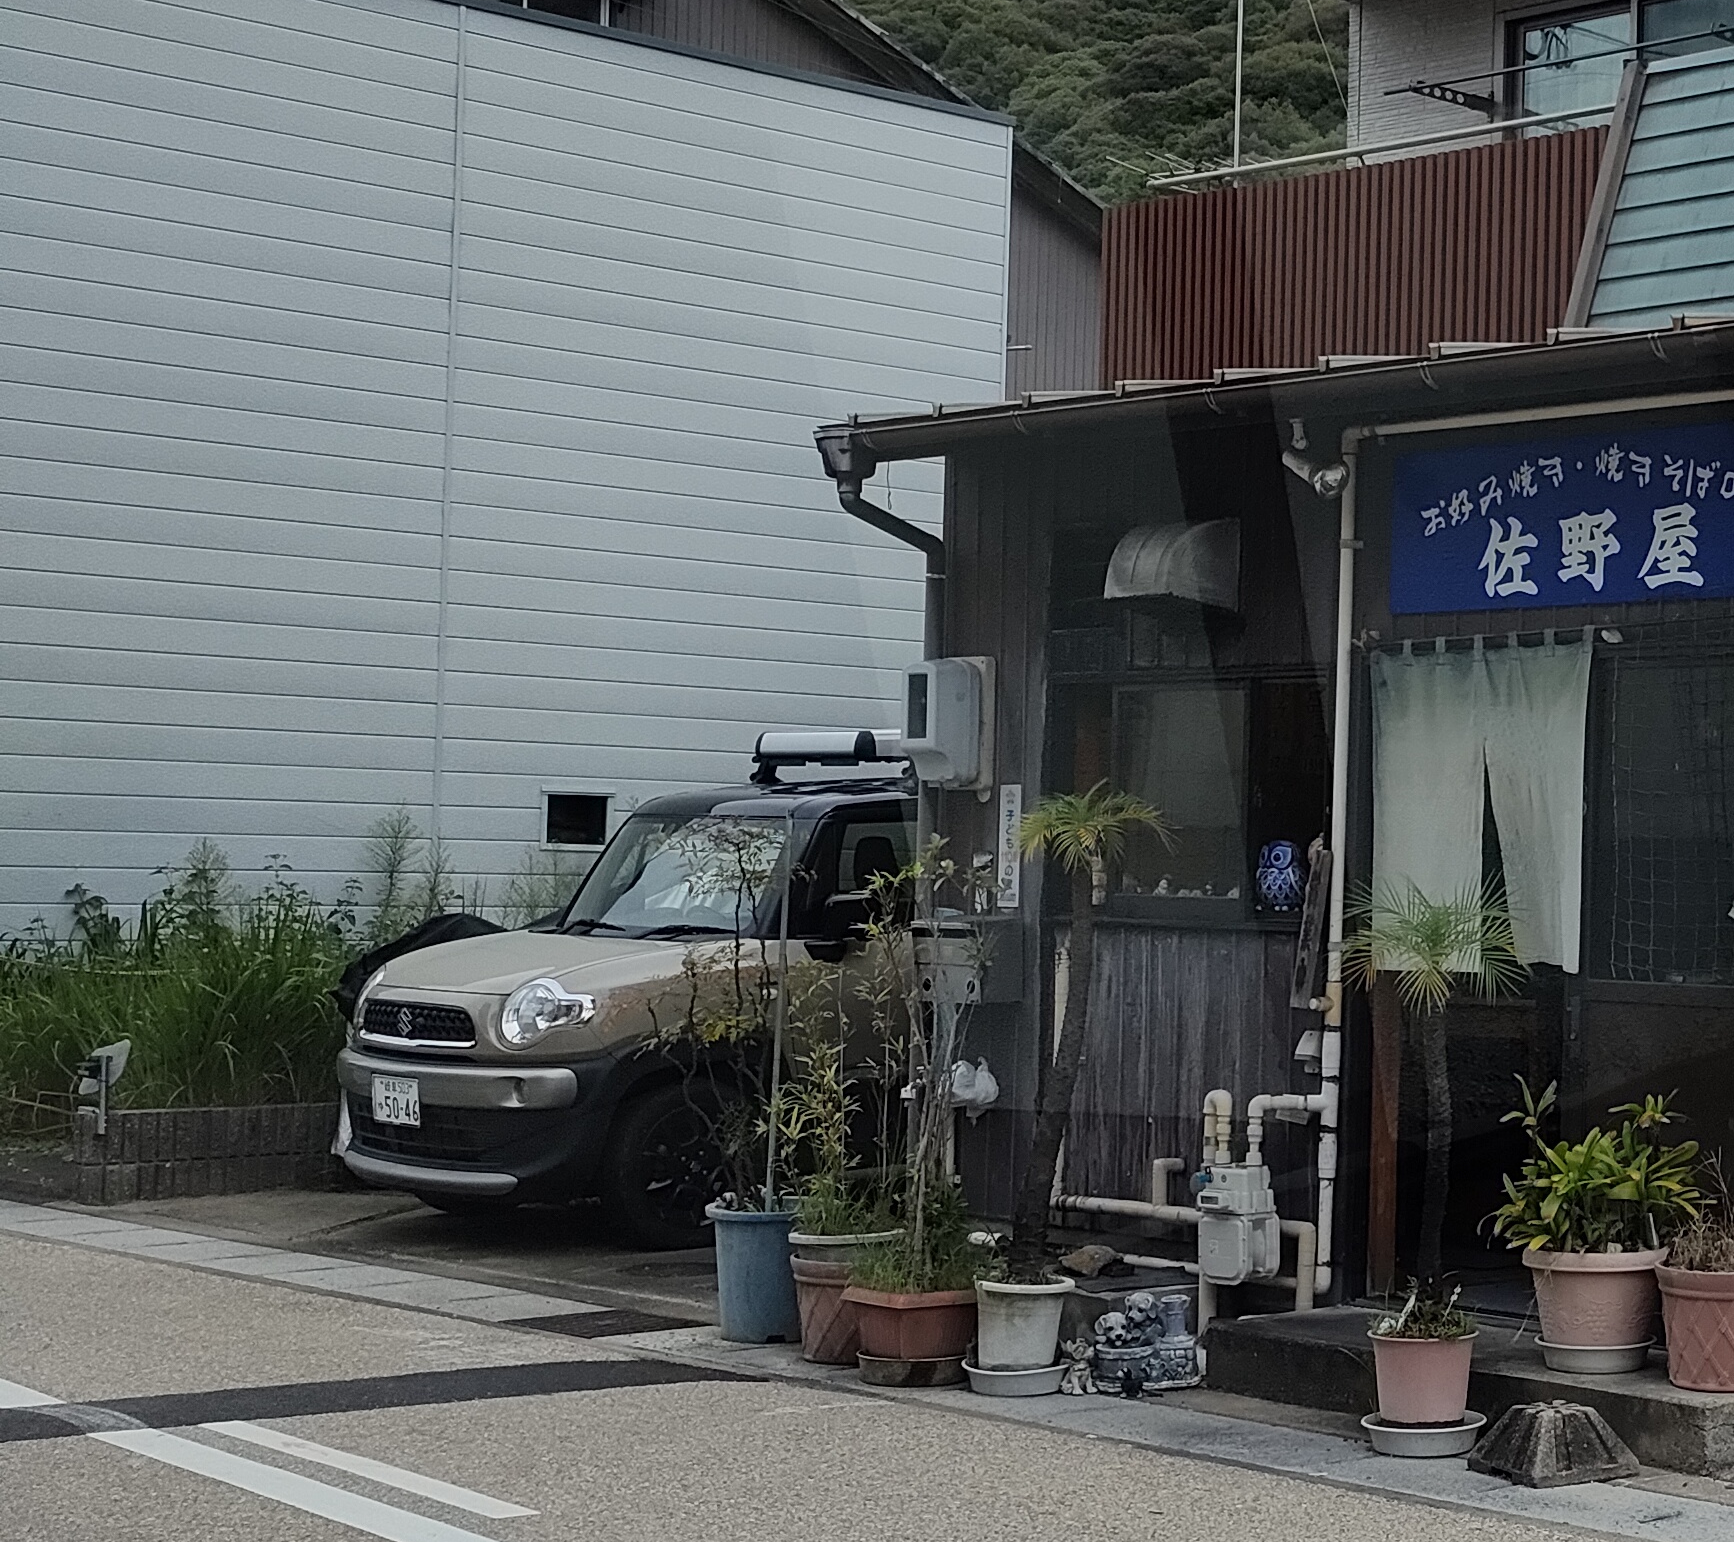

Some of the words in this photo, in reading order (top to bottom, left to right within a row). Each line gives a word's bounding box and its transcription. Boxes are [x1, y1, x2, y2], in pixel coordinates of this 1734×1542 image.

[1477, 502, 1704, 598] 佐野屋
[384, 1095, 419, 1122] 50-46
